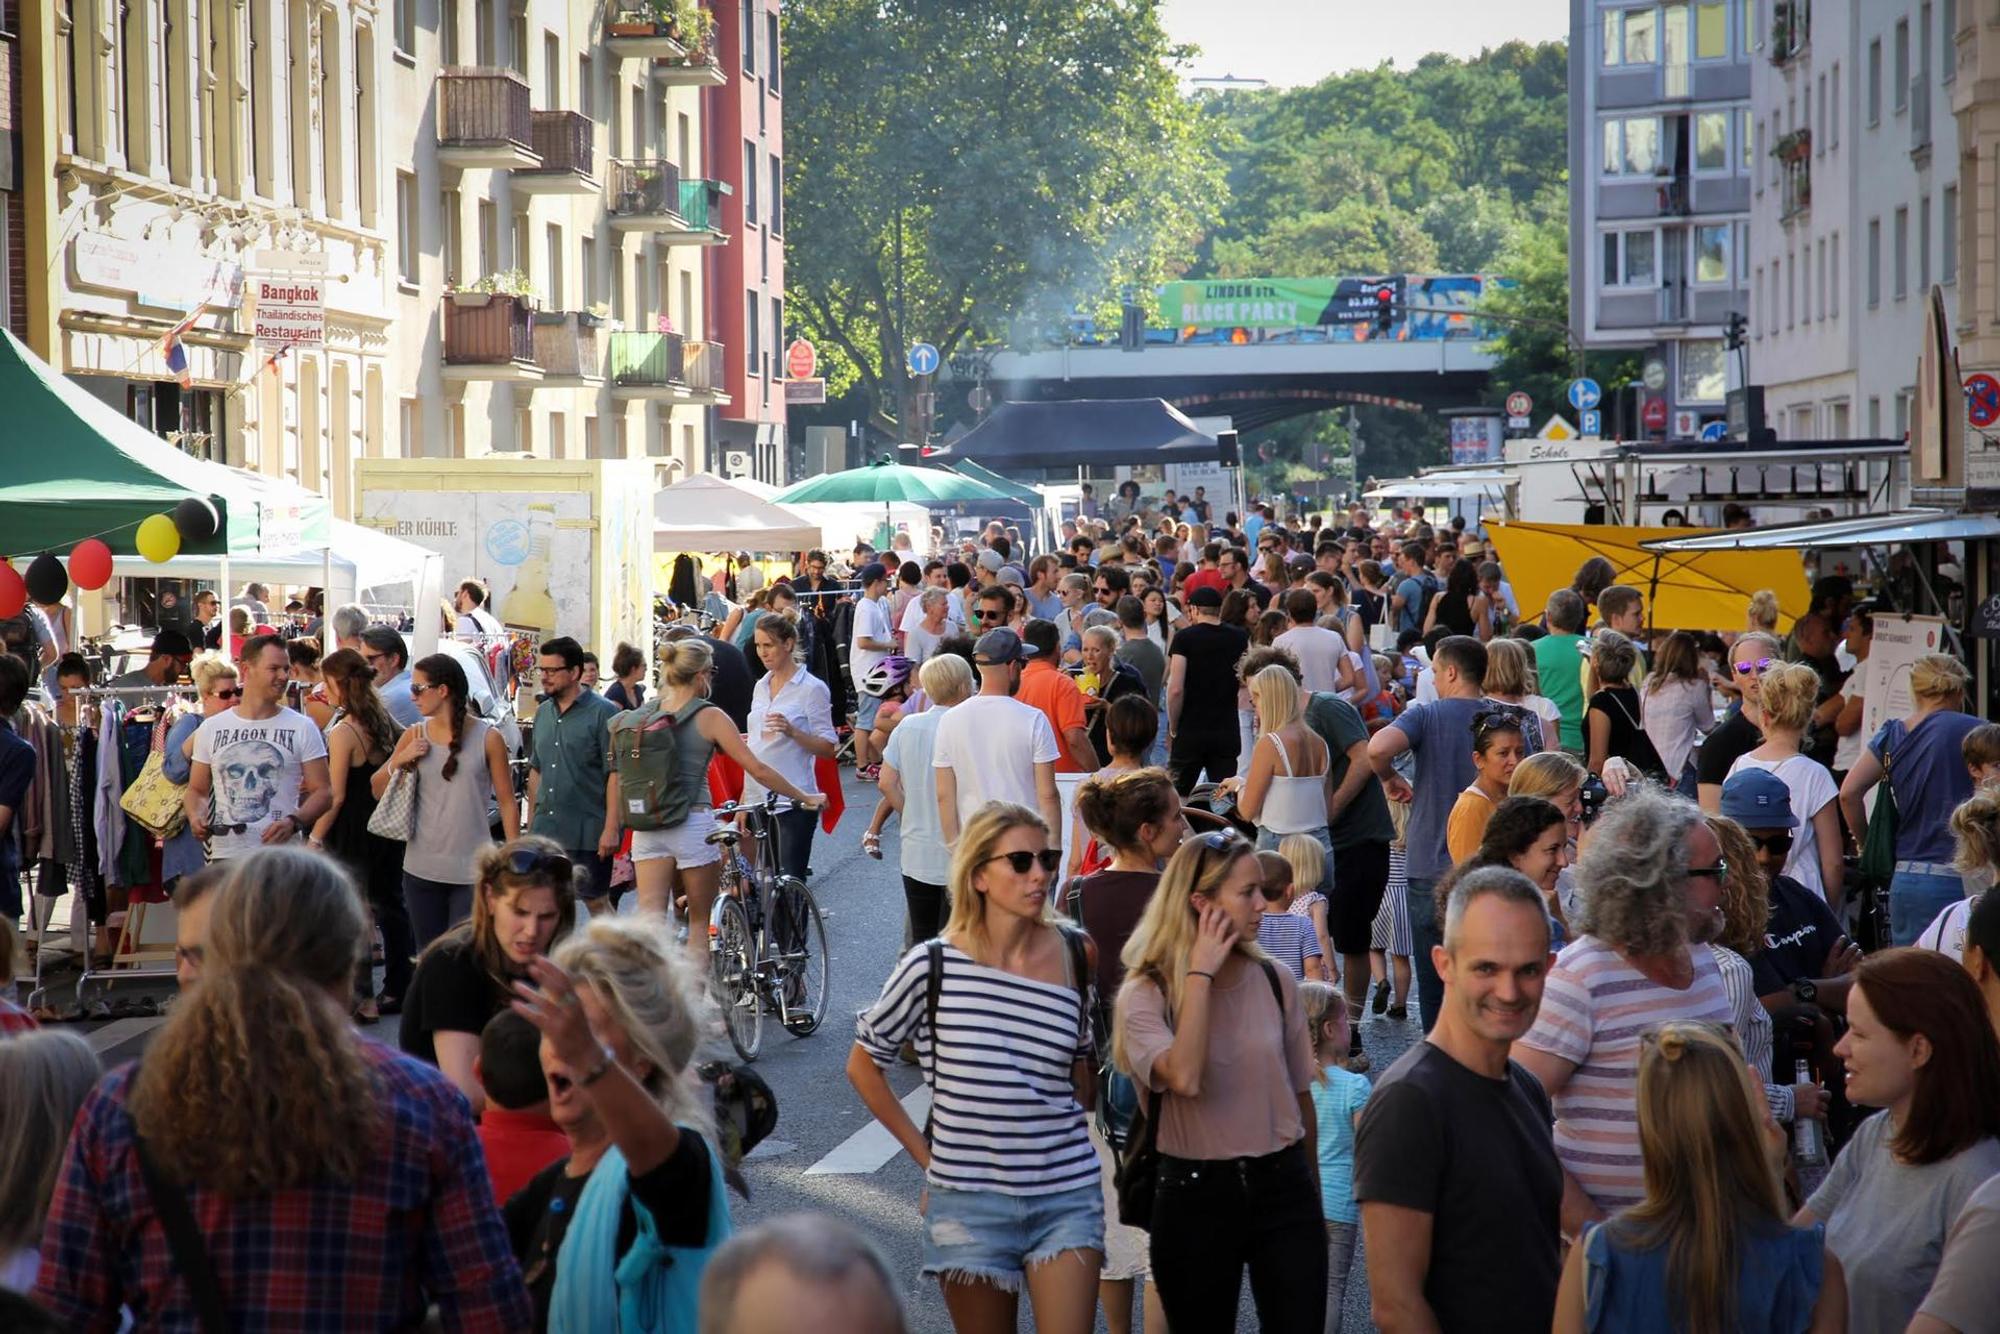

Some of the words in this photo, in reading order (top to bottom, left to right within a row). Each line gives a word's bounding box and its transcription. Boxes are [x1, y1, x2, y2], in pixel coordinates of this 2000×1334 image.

[261, 283, 318, 304] Bangkok
[1205, 285, 1252, 299] LINDEN
[256, 308, 323, 321] Thailändisches
[1182, 303, 1234, 322] BLOCK
[1240, 300, 1297, 321] PARTY
[256, 323, 322, 339] Restaurant
[213, 728, 267, 753] DRAGON
[273, 729, 296, 754] INK
